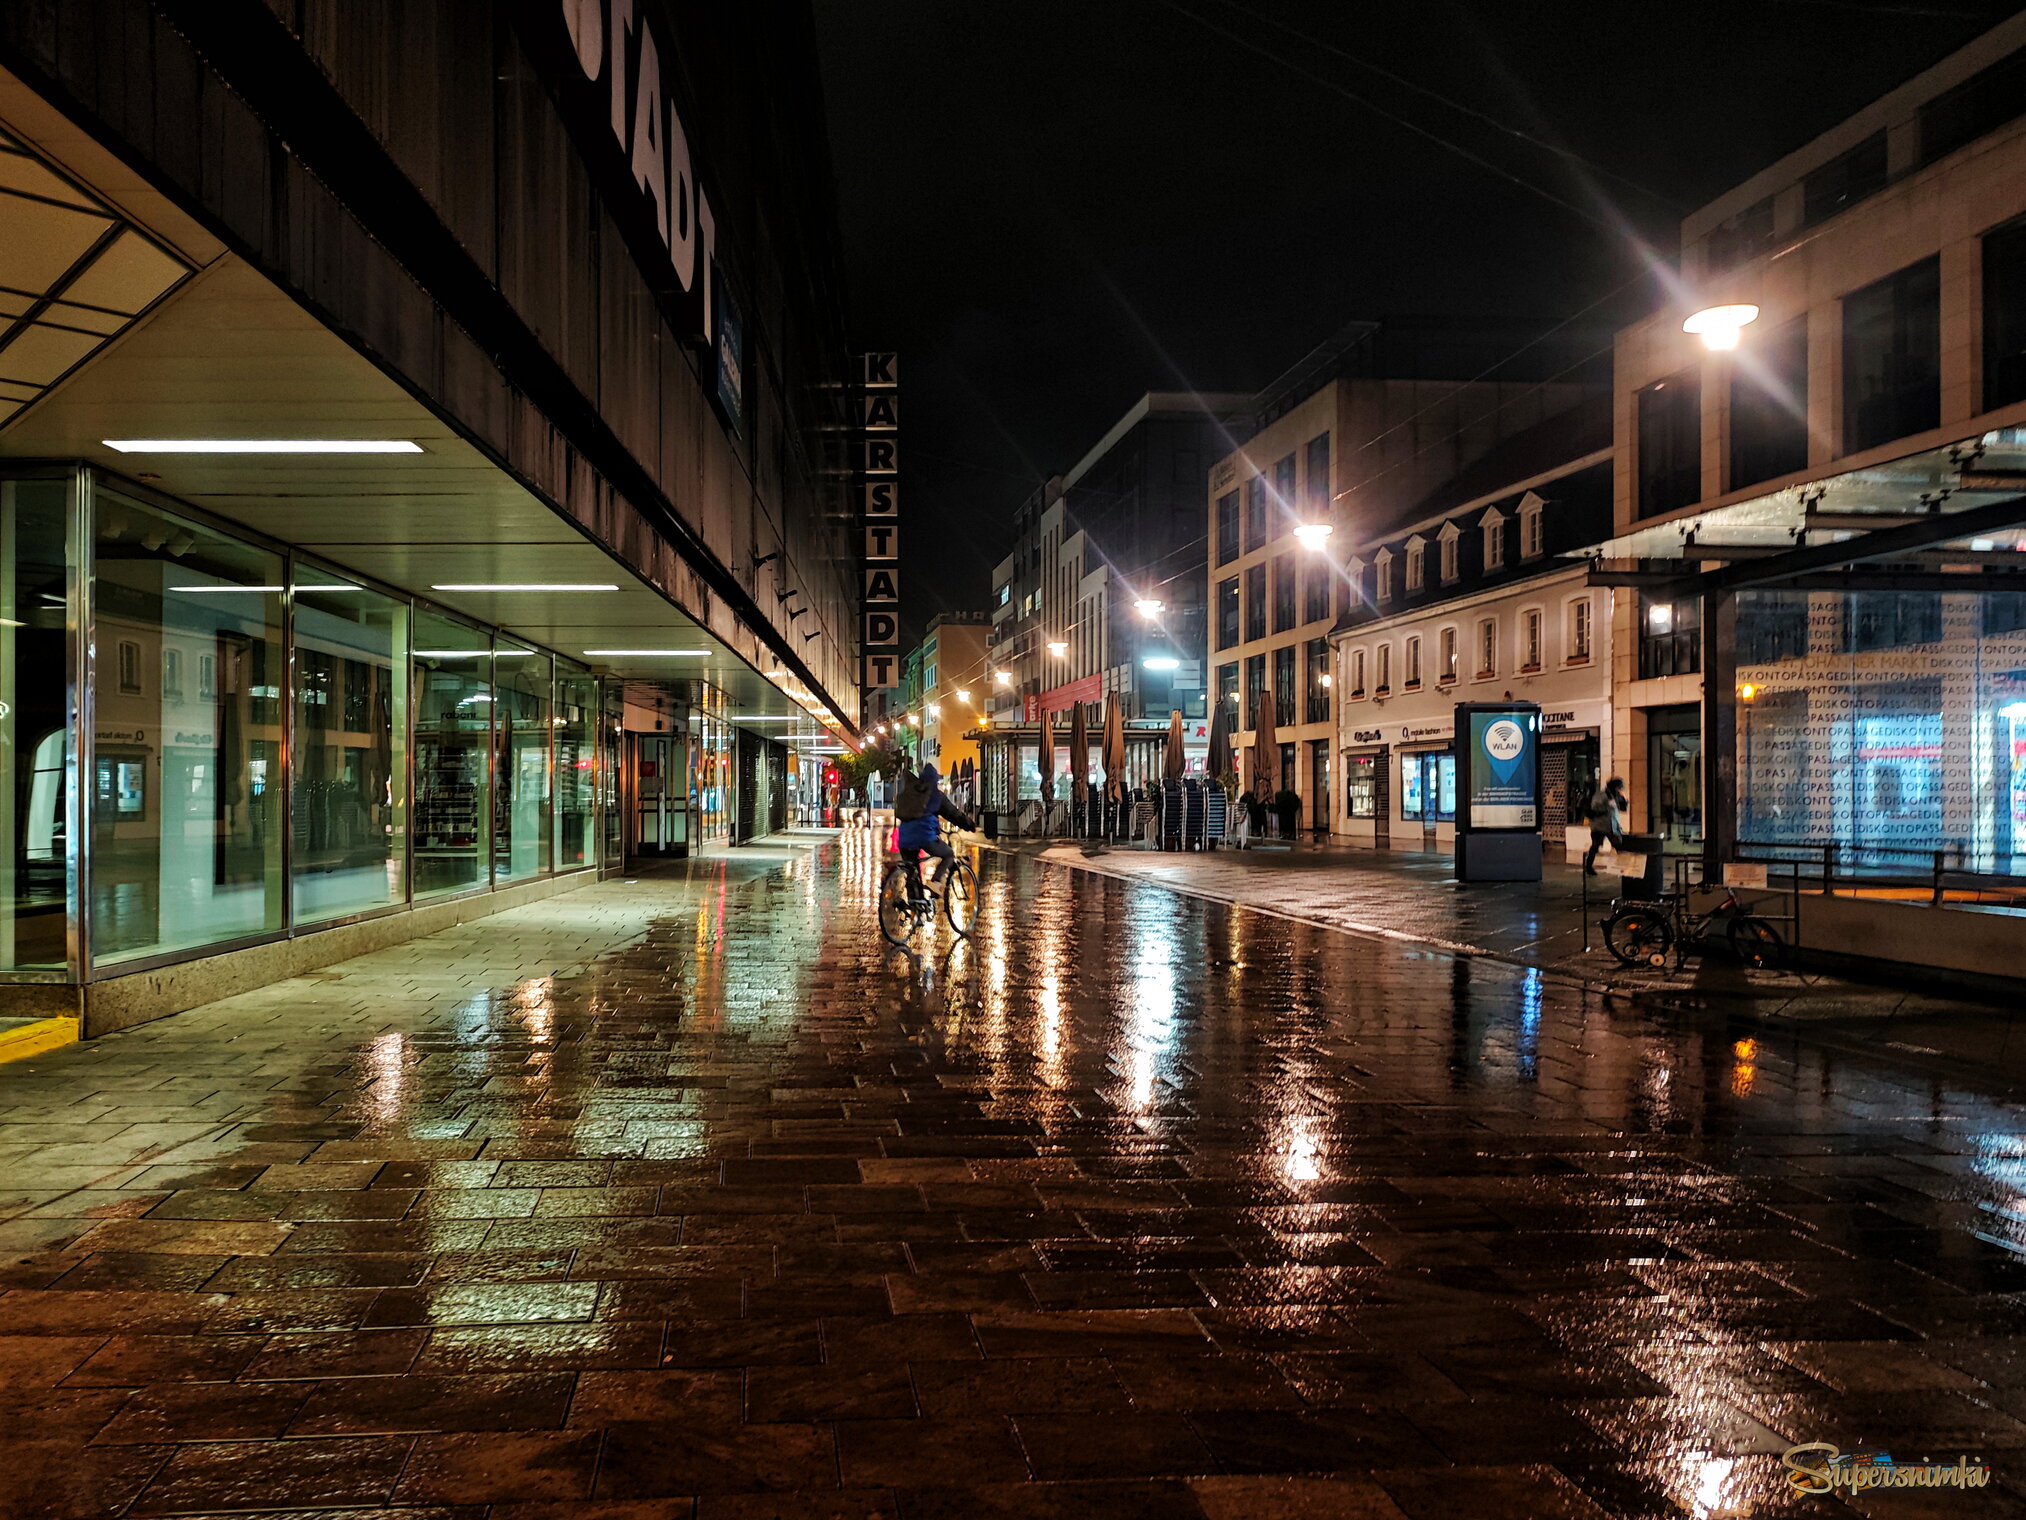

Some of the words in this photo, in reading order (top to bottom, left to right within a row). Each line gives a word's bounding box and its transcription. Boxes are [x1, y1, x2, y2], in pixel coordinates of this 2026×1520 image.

[867, 354, 899, 684] KARSTADT
[1880, 655, 1929, 670] MARKT
[1492, 742, 1517, 752] WLAN
